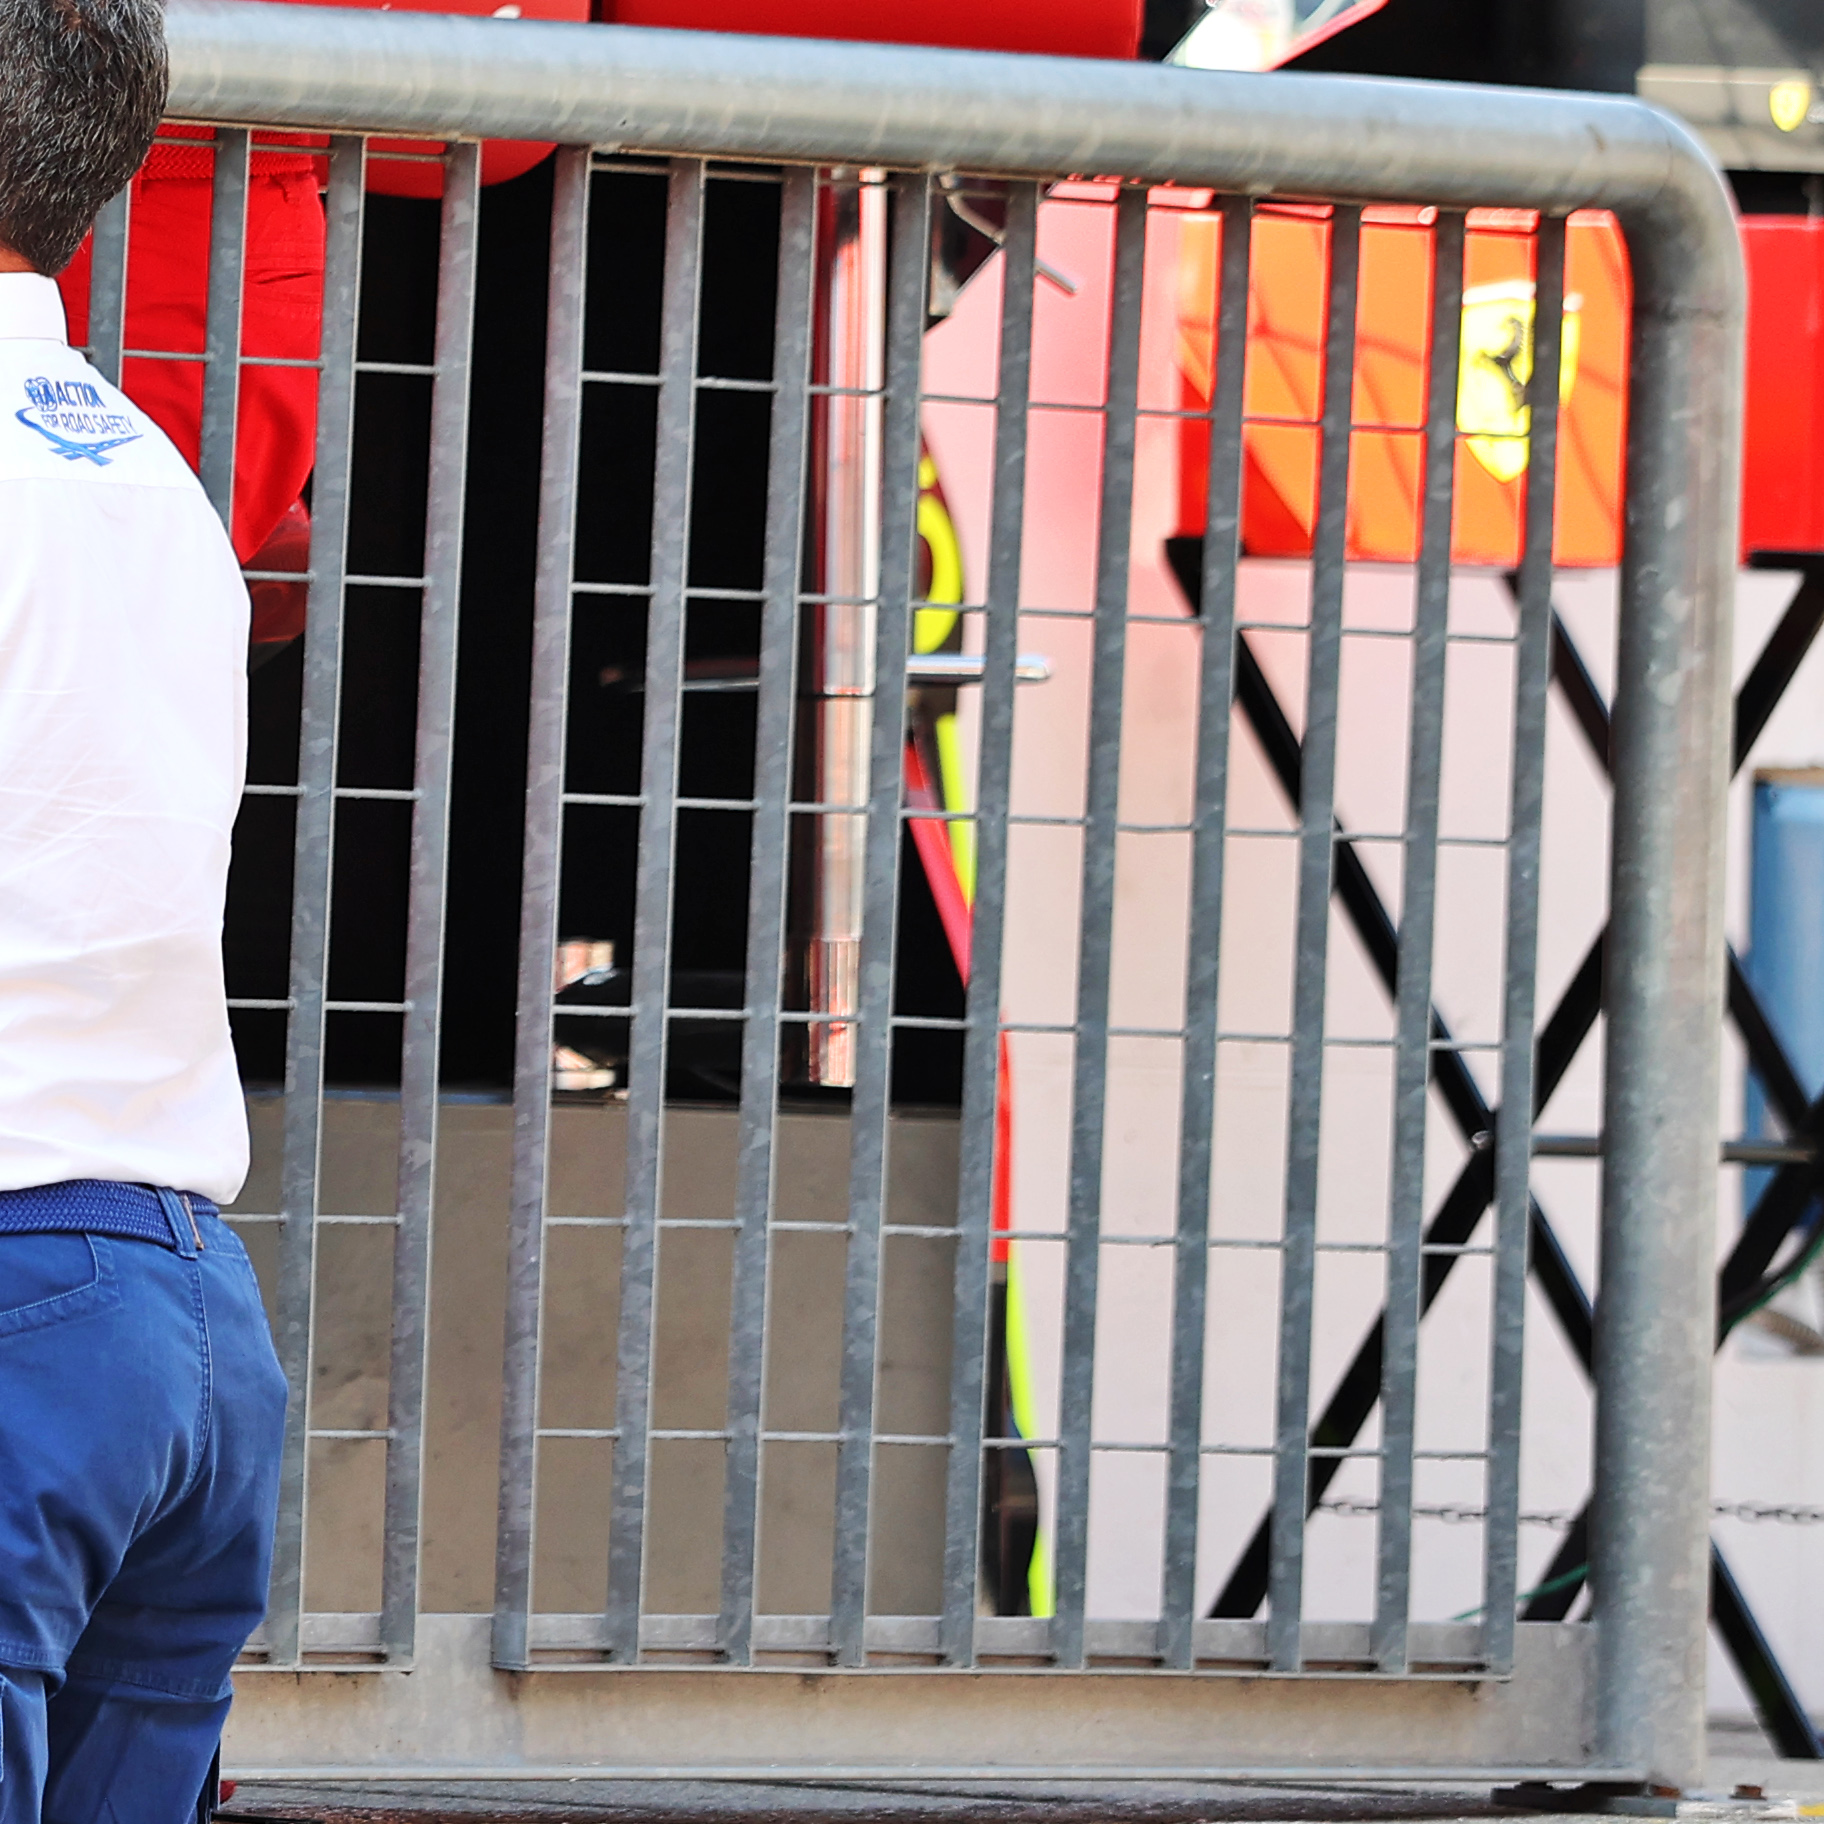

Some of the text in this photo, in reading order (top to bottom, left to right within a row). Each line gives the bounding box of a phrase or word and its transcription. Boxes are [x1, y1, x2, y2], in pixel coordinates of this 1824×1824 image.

[54, 380, 107, 409] ACTION
[59, 412, 97, 435] ROAD
[92, 412, 139, 435] SAFETY
